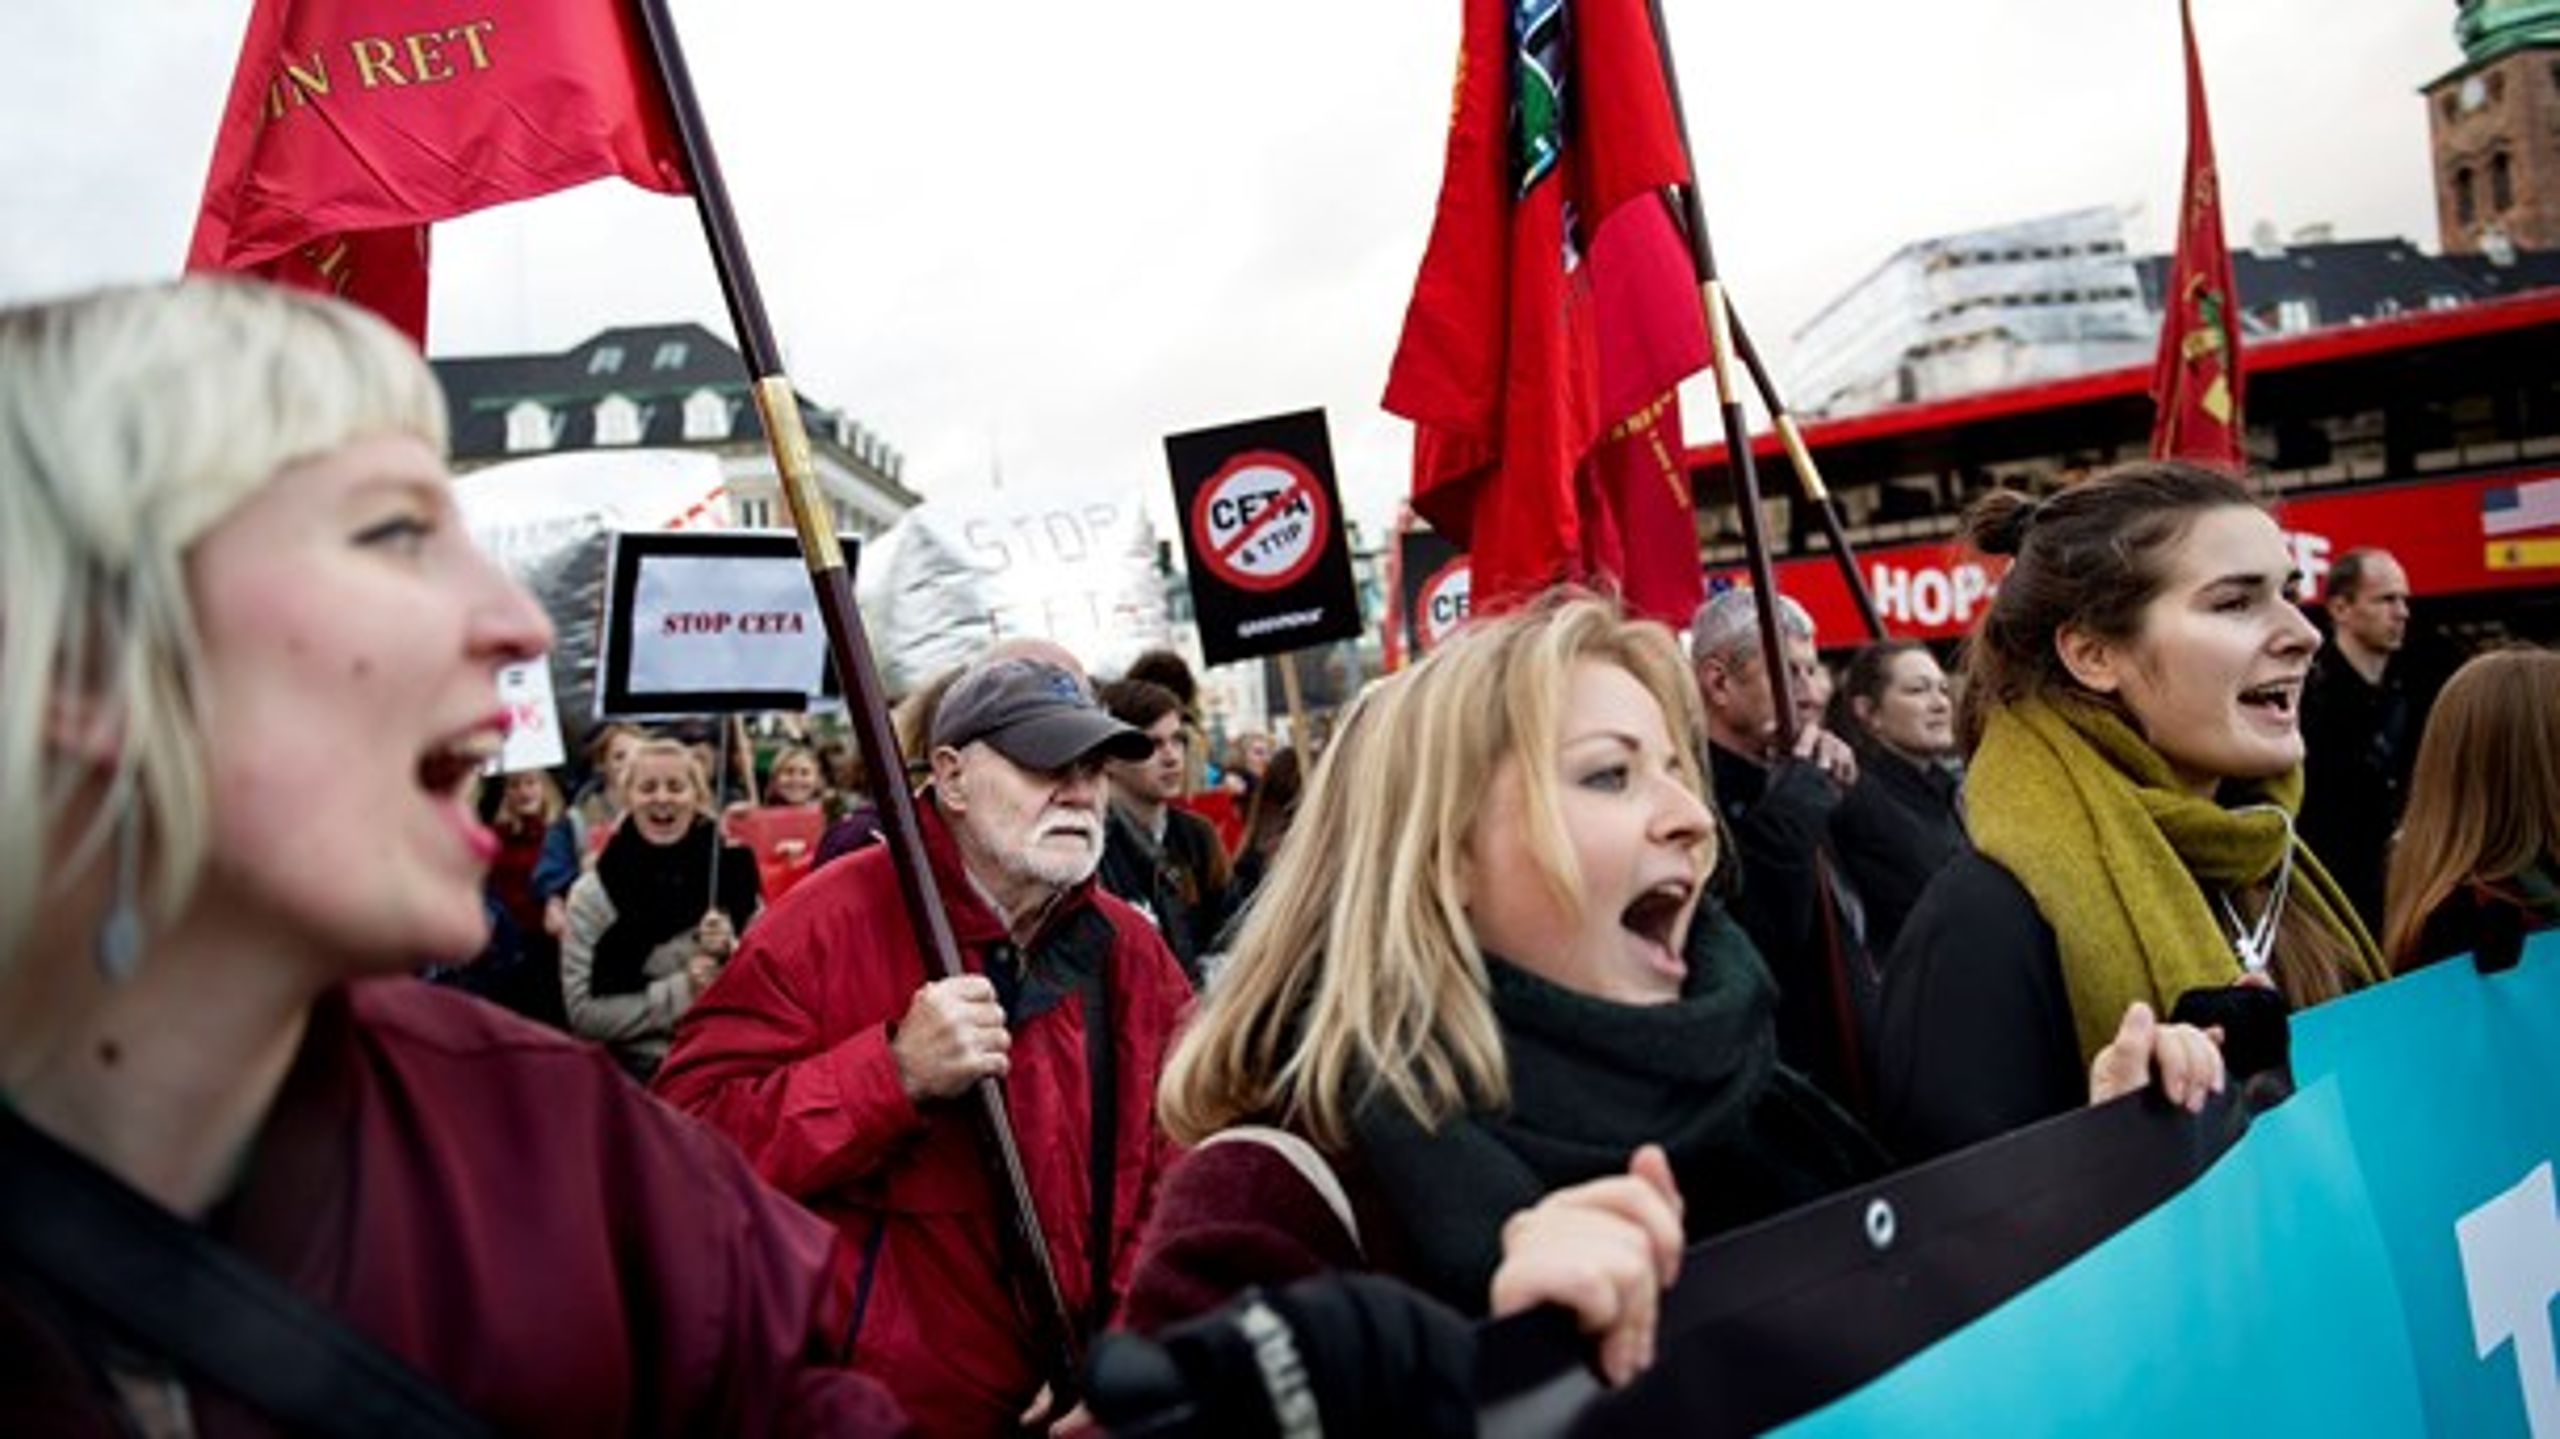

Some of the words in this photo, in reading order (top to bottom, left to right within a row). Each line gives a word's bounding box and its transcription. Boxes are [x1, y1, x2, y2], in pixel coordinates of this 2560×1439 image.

[351, 18, 494, 88] RET
[1211, 487, 1310, 530] CETA
[964, 502, 1119, 575] STOP
[663, 612, 732, 637] STOP
[737, 611, 804, 635] CETA
